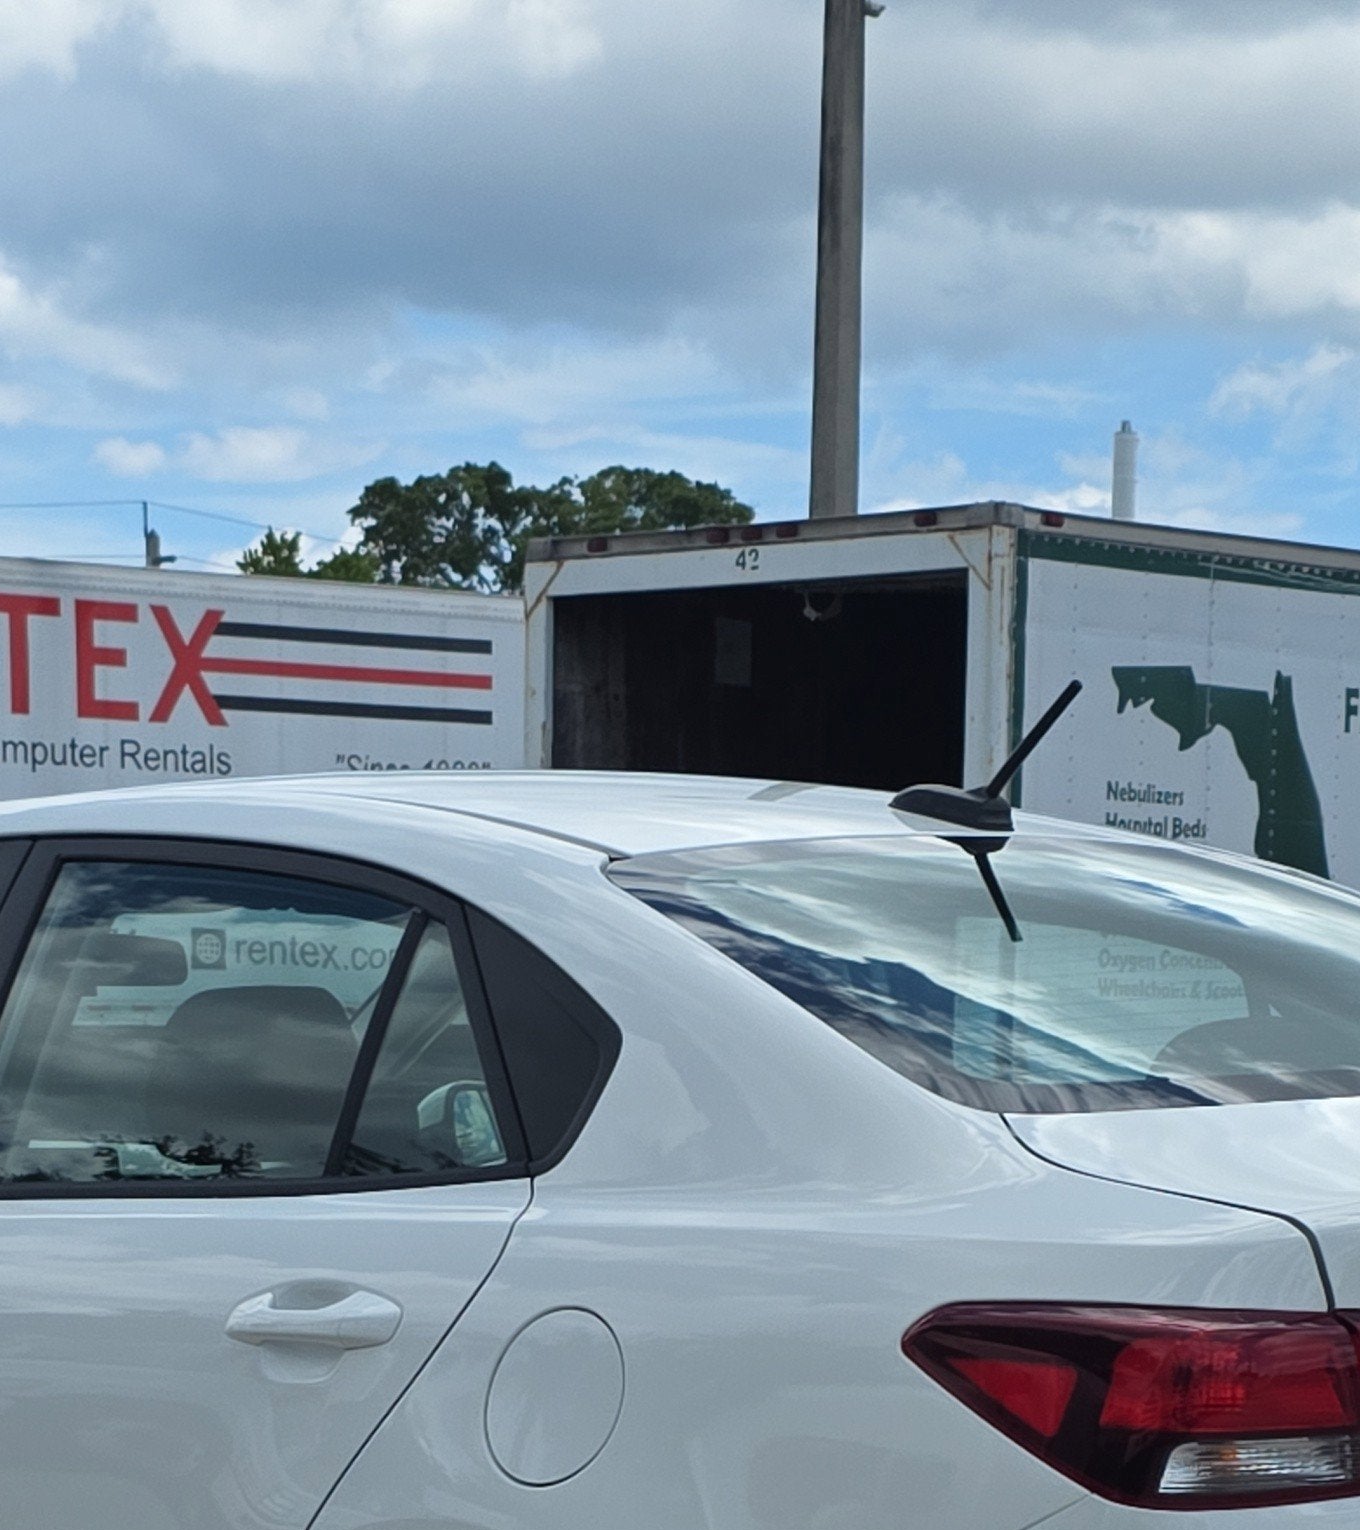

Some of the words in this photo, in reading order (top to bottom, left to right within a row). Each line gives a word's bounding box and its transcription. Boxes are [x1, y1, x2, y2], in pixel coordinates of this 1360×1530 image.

[735, 548, 759, 571] 42
[119, 739, 232, 776] Rentals
[1106, 780, 1184, 806] Nebulizers
[1172, 817, 1207, 840] Beds
[1097, 947, 1156, 973] Oxygen
